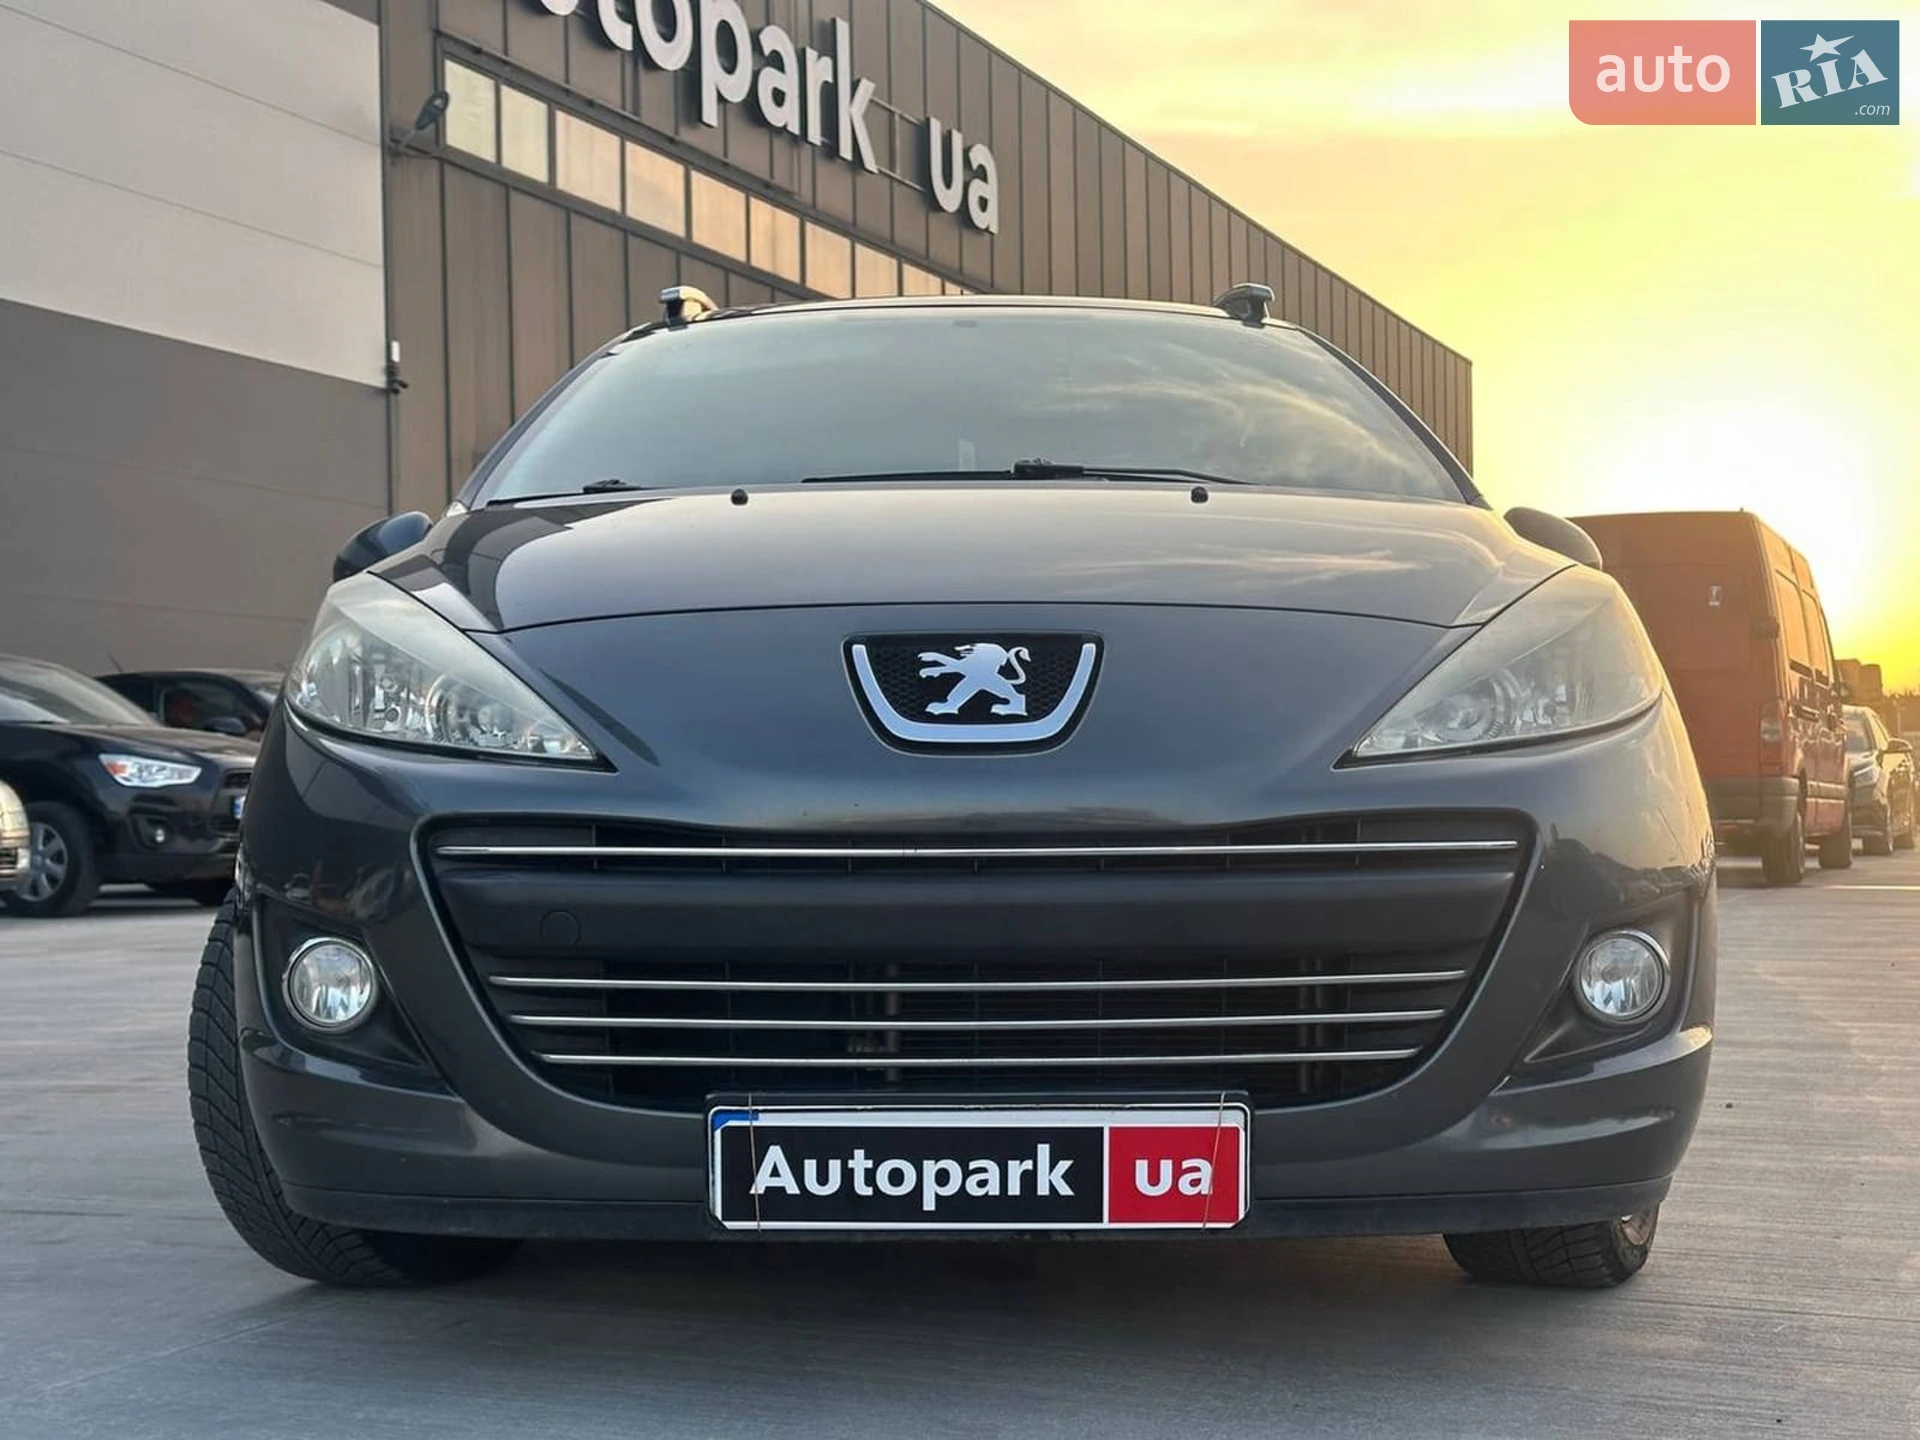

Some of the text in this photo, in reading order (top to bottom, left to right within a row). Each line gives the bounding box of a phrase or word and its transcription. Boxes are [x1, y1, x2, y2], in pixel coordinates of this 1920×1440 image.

[540, 0, 998, 234] opark ua
[749, 1143, 1213, 1211] Autopark ua
